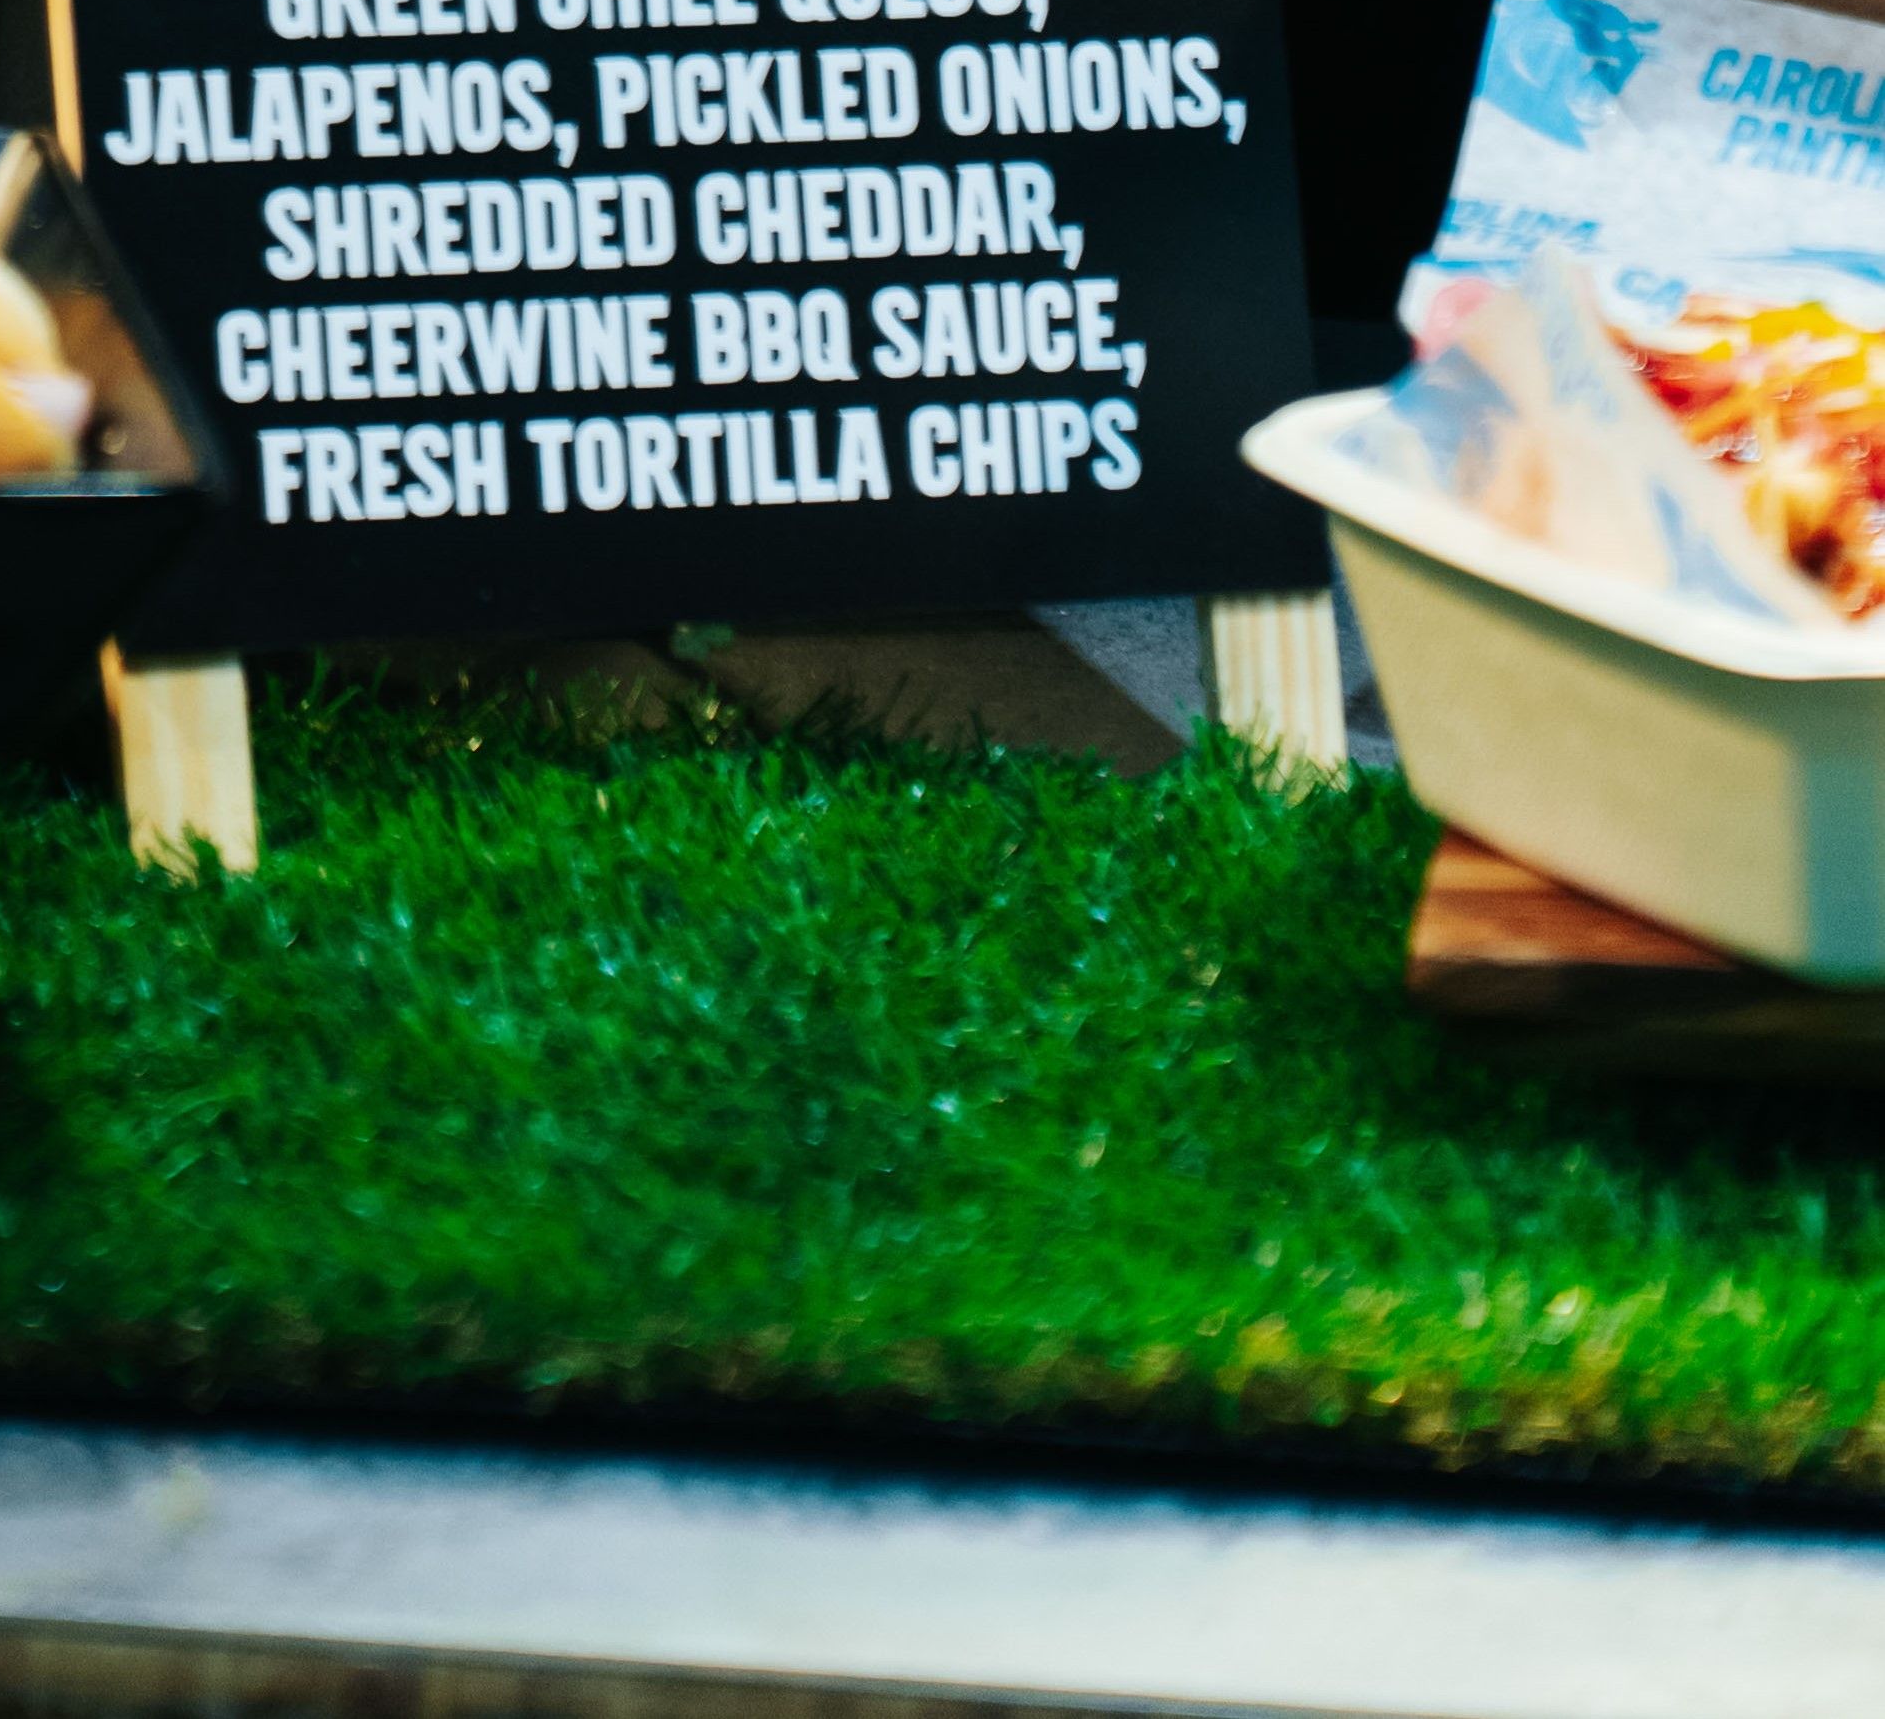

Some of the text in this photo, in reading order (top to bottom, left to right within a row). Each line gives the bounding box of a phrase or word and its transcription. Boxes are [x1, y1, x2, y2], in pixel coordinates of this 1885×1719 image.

[105, 38, 1245, 167] JALAPENOS, PICKLED ONIONS,
[265, 163, 1082, 280] SHREDDED CHEDDAR,
[218, 279, 1145, 403] CHEERWINE BBQ SAUCE,
[259, 400, 1140, 523] FRESH TORTILLA CHIPS
